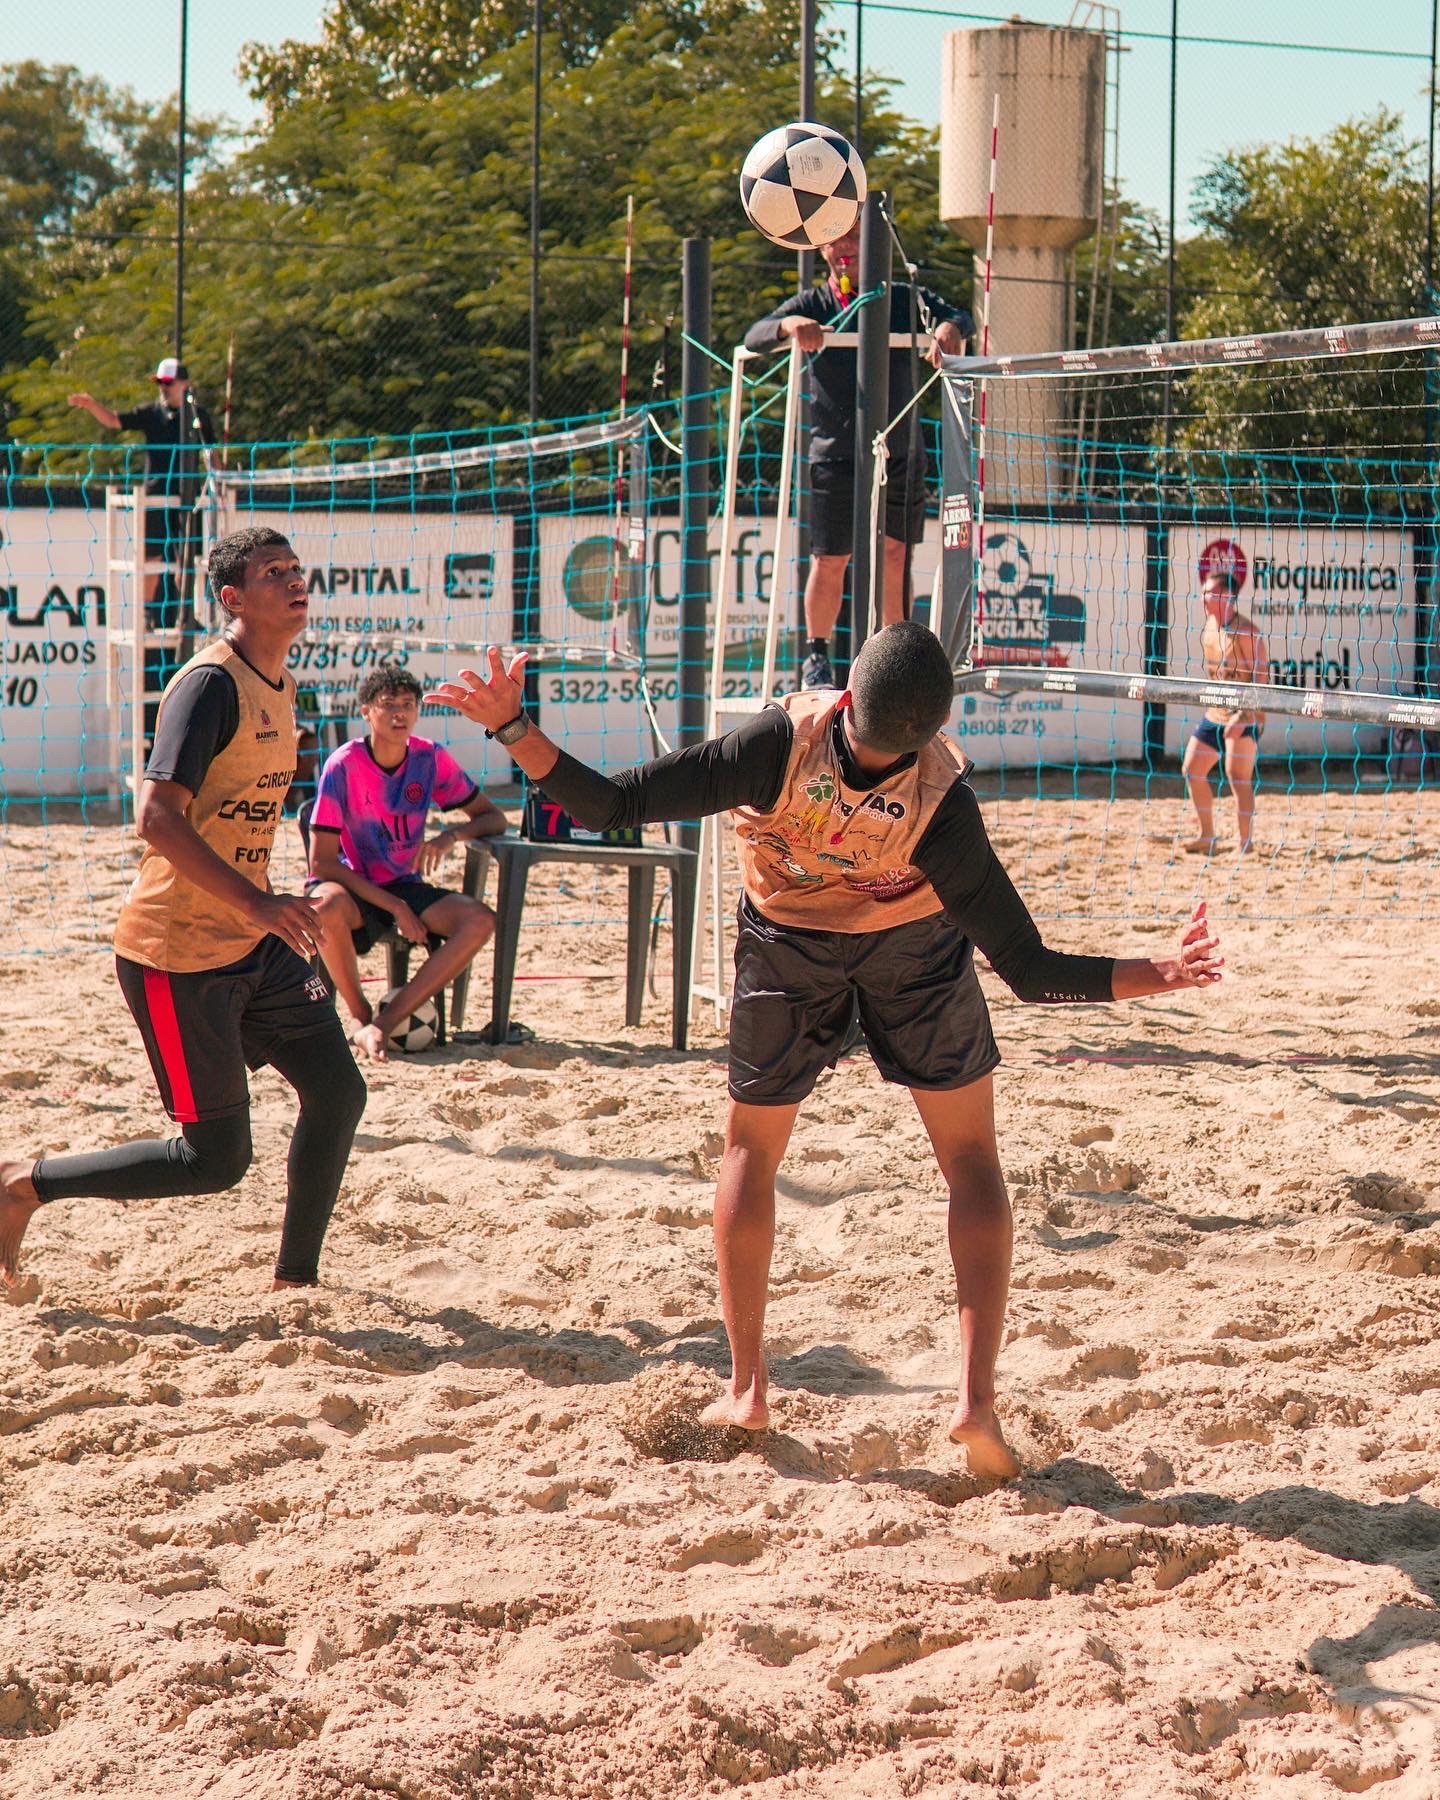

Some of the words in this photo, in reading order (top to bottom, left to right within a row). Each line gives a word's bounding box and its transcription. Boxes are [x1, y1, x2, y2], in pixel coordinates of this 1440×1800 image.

[943, 507, 971, 525] ARENA
[975, 597, 1044, 619] AFAEL
[0, 675, 38, 706] 10
[217, 800, 277, 822] CASA
[1044, 992, 1087, 1001] KIPSTA
